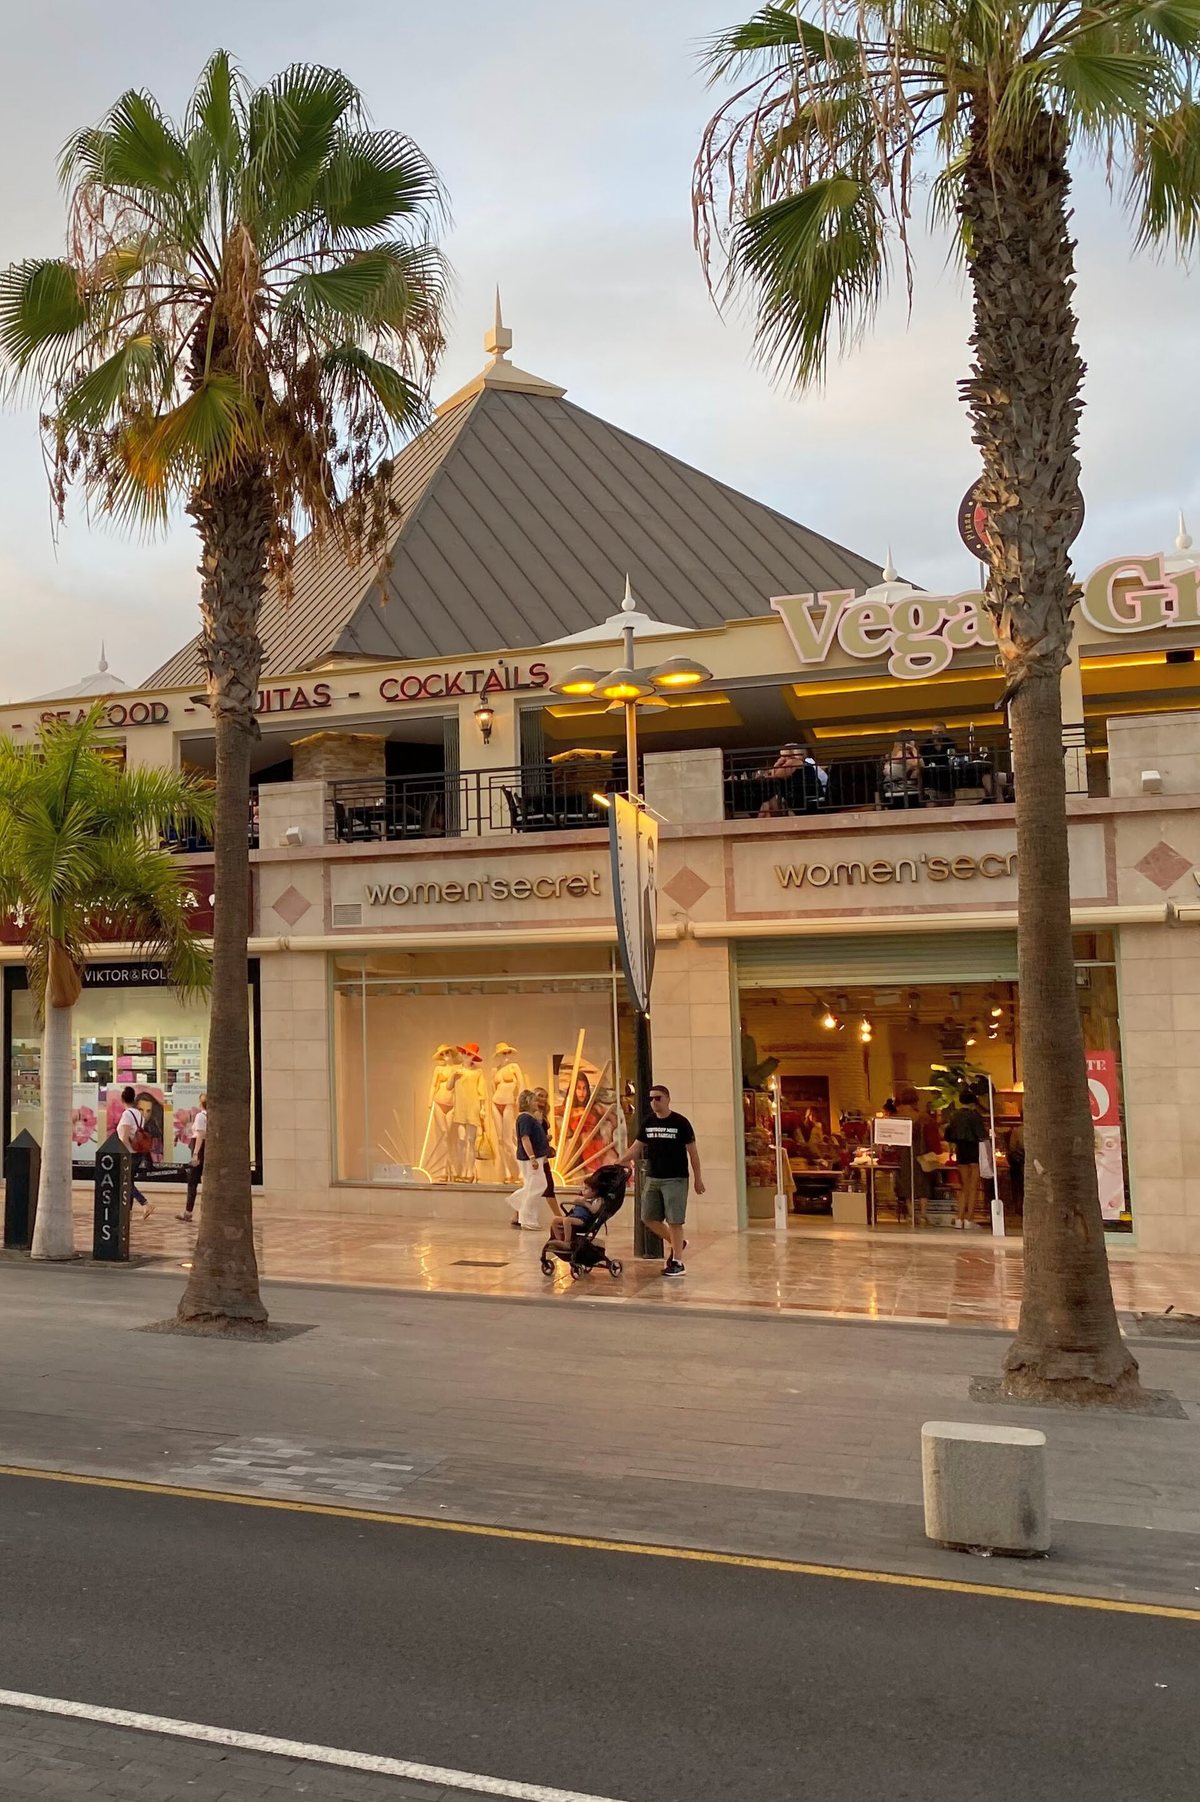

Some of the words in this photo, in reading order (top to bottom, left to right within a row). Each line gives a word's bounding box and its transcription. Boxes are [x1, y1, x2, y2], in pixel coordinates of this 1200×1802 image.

[770, 589, 998, 680] Vega
[380, 662, 550, 701] COCKTAILS
[365, 869, 601, 905] women'secret
[774, 851, 1018, 888] women'secr
[101, 1154, 114, 1241] OASIS
